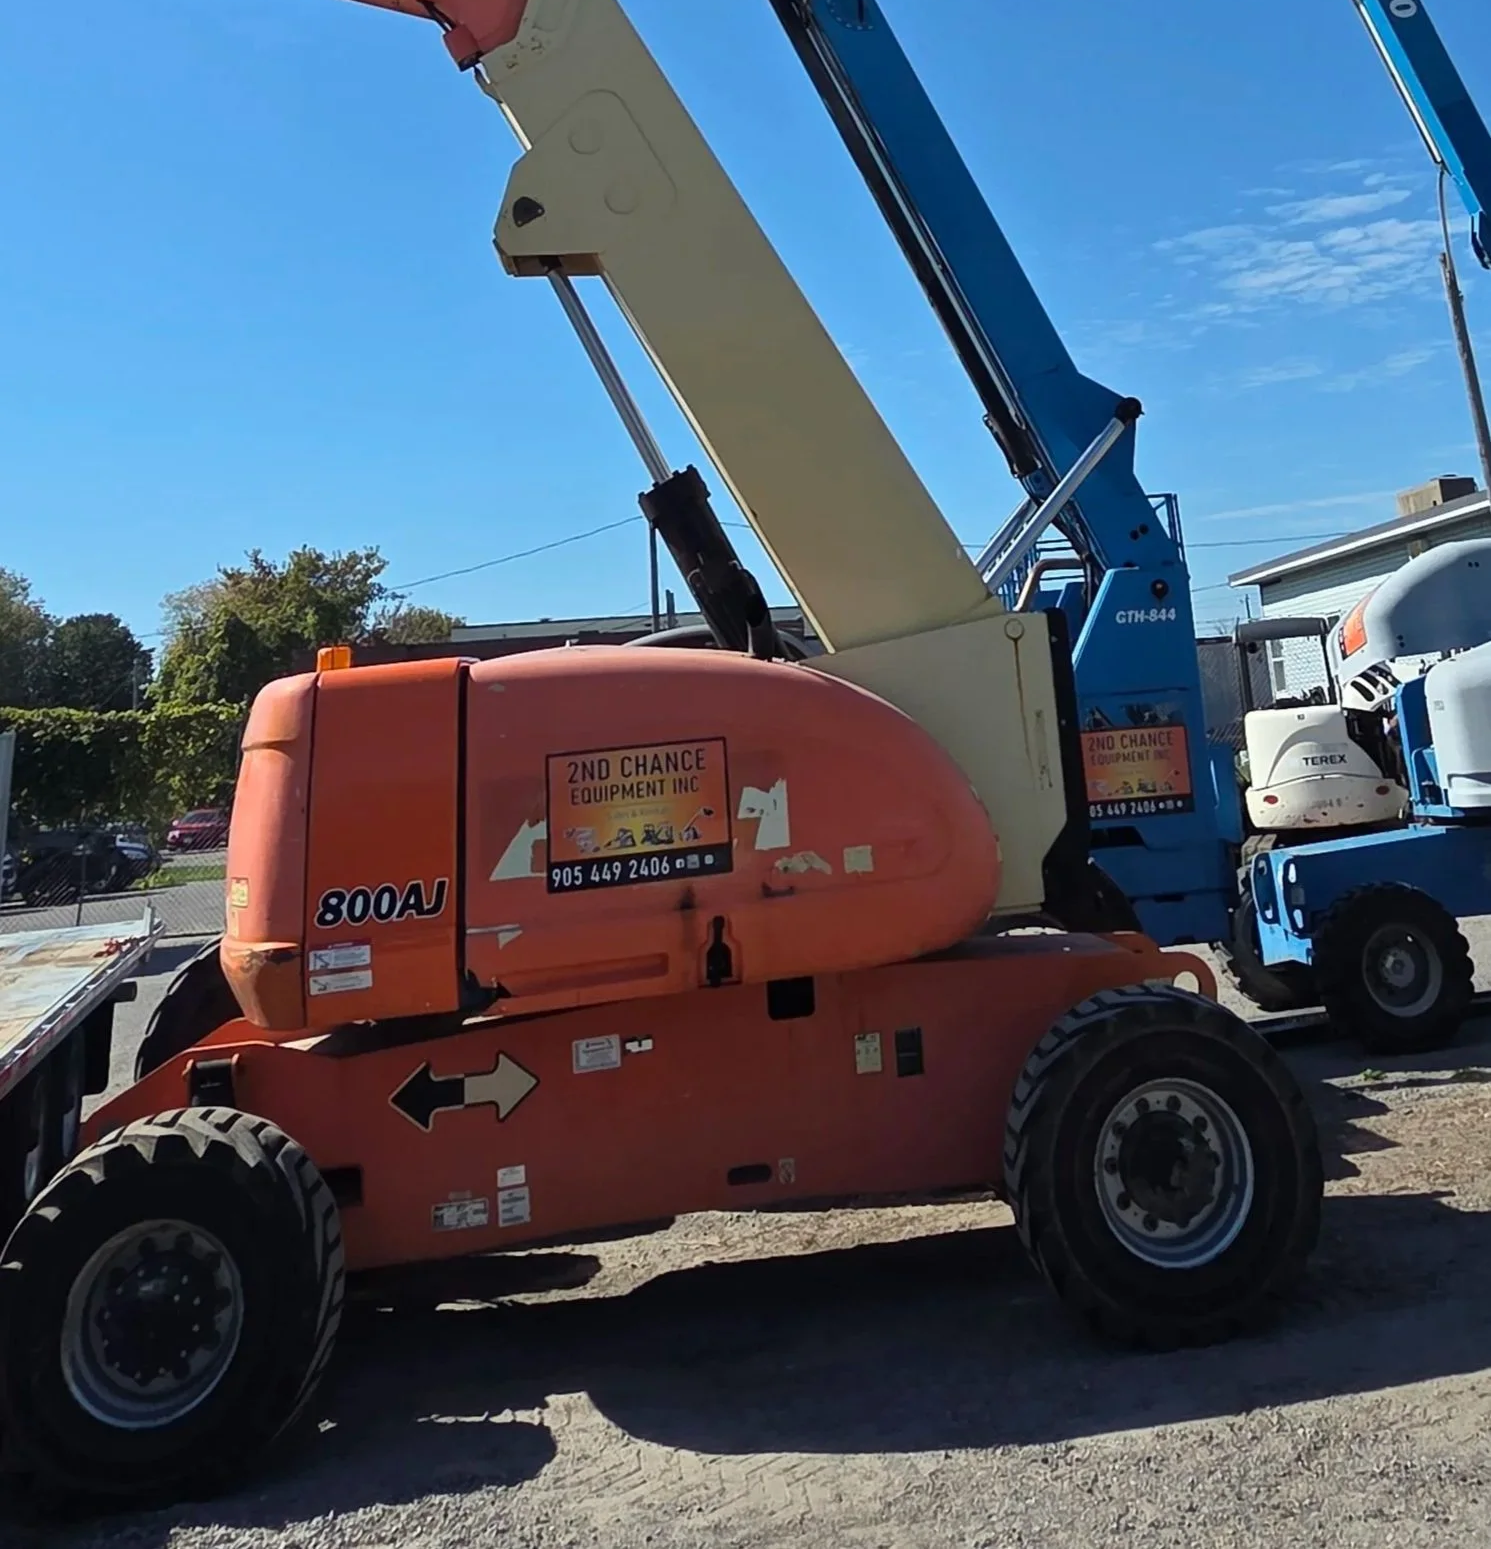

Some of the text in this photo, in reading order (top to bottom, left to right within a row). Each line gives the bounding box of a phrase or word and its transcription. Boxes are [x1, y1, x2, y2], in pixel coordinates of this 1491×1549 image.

[1115, 607, 1177, 624] GTH-844
[1120, 730, 1174, 750] CHANCE
[567, 748, 706, 784] 2ND CHANCE
[1090, 749, 1150, 766] EQUIPMENT
[1302, 753, 1348, 766] TEREX
[570, 776, 700, 806] EQUIPMENT INC
[1089, 804, 1103, 818] 05
[1106, 802, 1127, 815] 449
[552, 855, 670, 887] 905 449 2406
[314, 877, 449, 929] 800AJ
